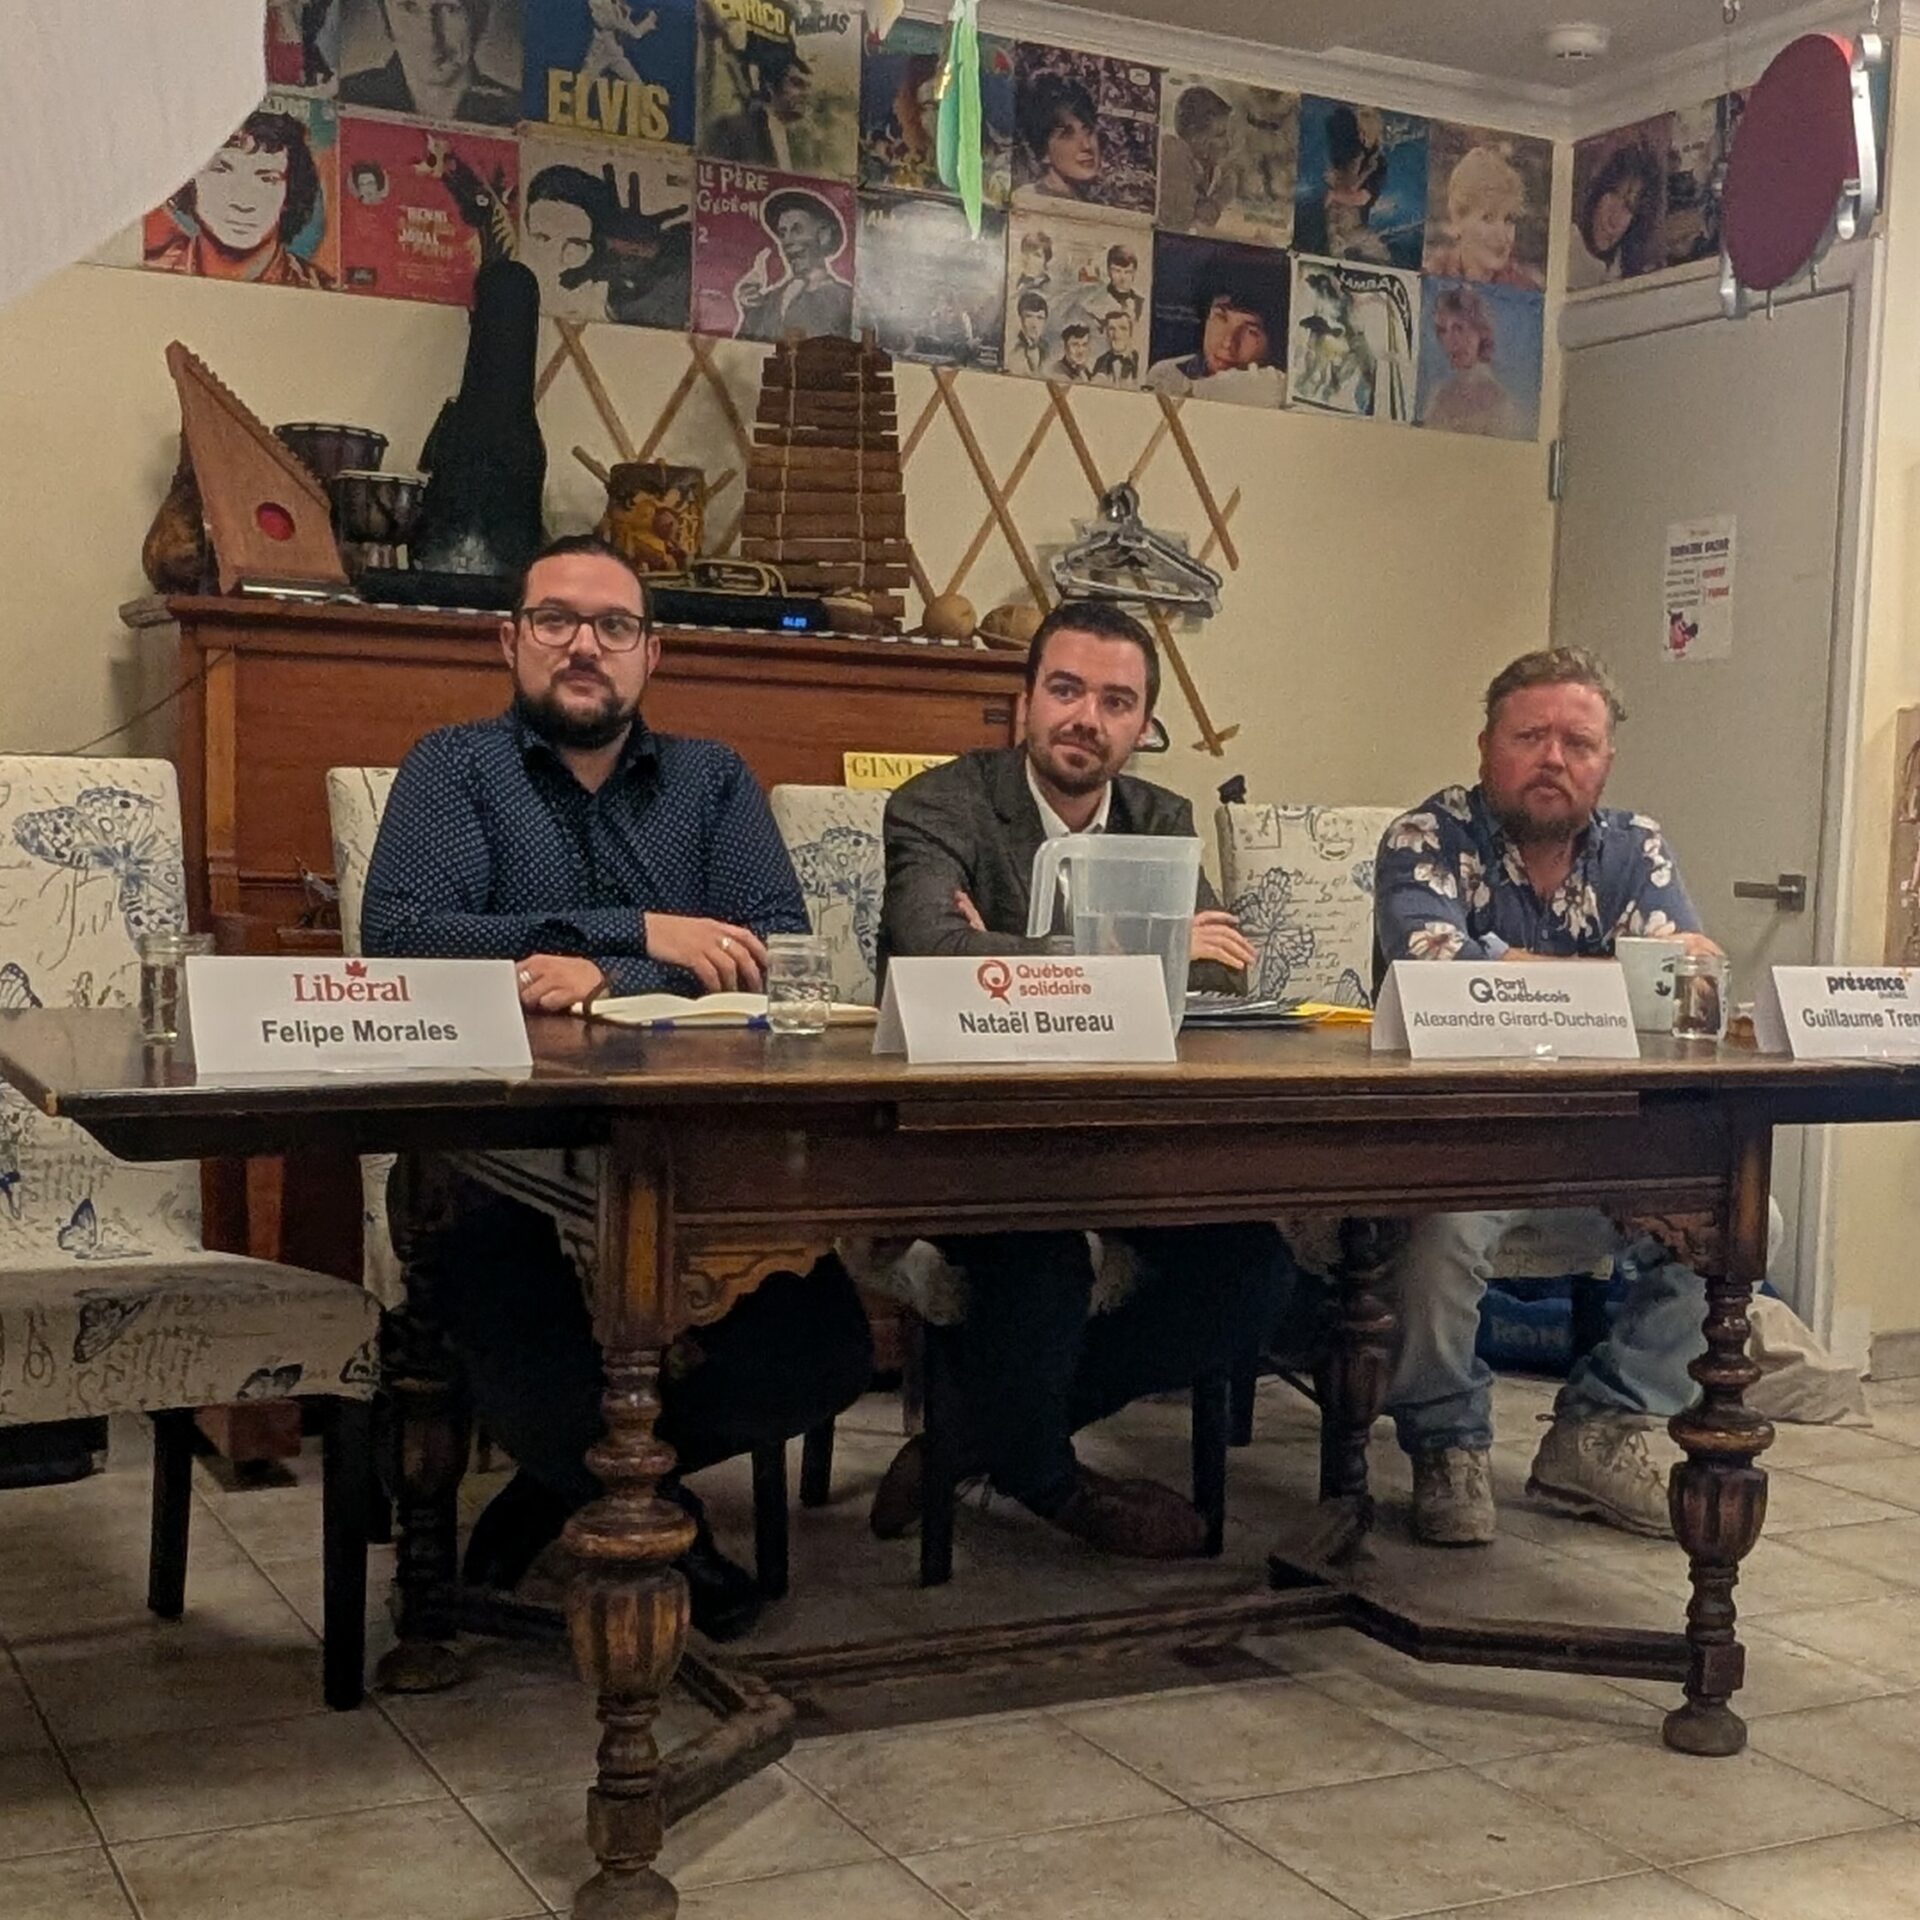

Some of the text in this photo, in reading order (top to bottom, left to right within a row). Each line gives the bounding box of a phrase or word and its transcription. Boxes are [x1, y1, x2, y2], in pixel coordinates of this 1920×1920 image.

[547, 67, 670, 141] ELVIS
[698, 226, 709, 244] 2
[852, 756, 913, 778] GINO
[1016, 964, 1084, 979] Québec
[293, 972, 411, 1002] Libéral
[1019, 981, 1092, 996] solidaire
[1494, 977, 1527, 991] Parti
[1827, 972, 1905, 994] présence
[1497, 990, 1570, 1003] Québécois
[959, 1010, 1114, 1034] Nataël Bureau
[1413, 1010, 1627, 1029] Alexandre Girard-Duchaine
[1802, 1008, 1883, 1027] Guillaume
[262, 1019, 458, 1048] Felipe Morales
